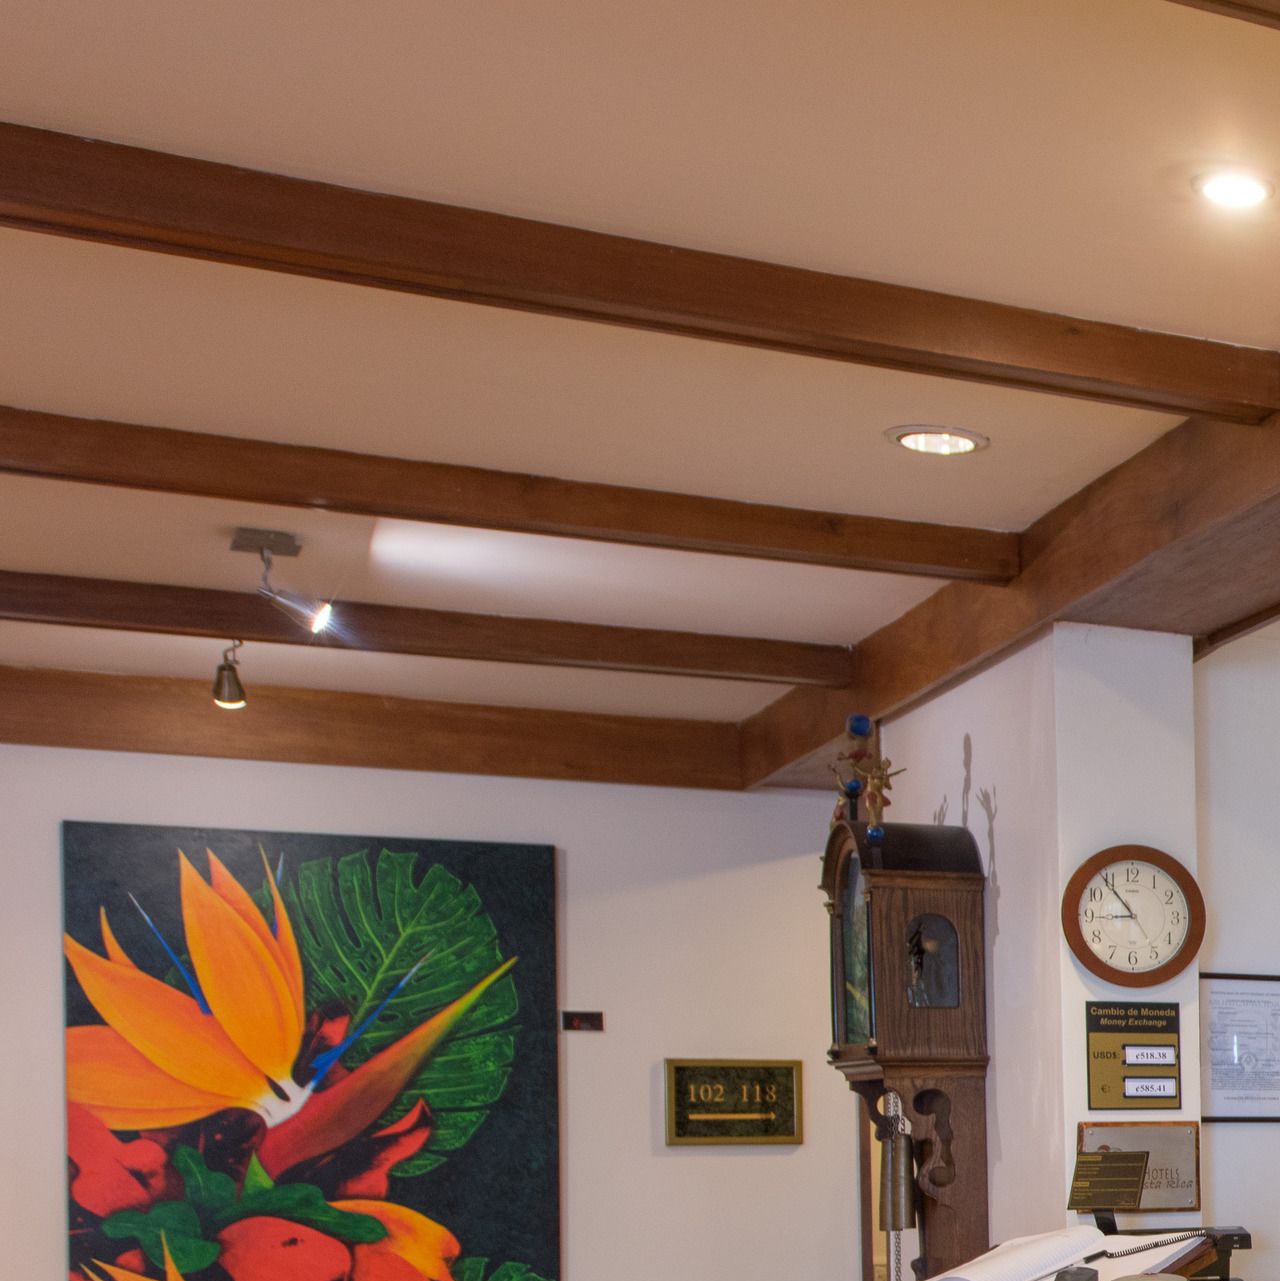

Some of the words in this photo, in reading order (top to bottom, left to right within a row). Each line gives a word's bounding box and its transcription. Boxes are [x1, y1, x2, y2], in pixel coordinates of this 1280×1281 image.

[1126, 868, 1139, 883] 12
[1152, 875, 1156, 889] 1
[1089, 887, 1103, 902] 10
[1164, 890, 1173, 904] 2
[1084, 909, 1094, 923] 9
[1171, 911, 1180, 925] 3
[1092, 929, 1101, 943] 8
[1163, 931, 1171, 945] 4
[1108, 945, 1117, 959] 7
[1128, 951, 1138, 966] 6
[1149, 945, 1158, 960] 5
[1090, 1007, 1125, 1016] Cambio
[1127, 1007, 1138, 1016] de
[1140, 1007, 1176, 1016] Moneda
[1100, 1017, 1127, 1028] Money
[1128, 1018, 1167, 1028] Exchange
[689, 1084, 724, 1103] 102
[741, 1084, 776, 1103] 118
[1145, 1167, 1180, 1180] HOTELS
[1143, 1179, 1161, 1190] sta
[1166, 1180, 1194, 1190] Rica
